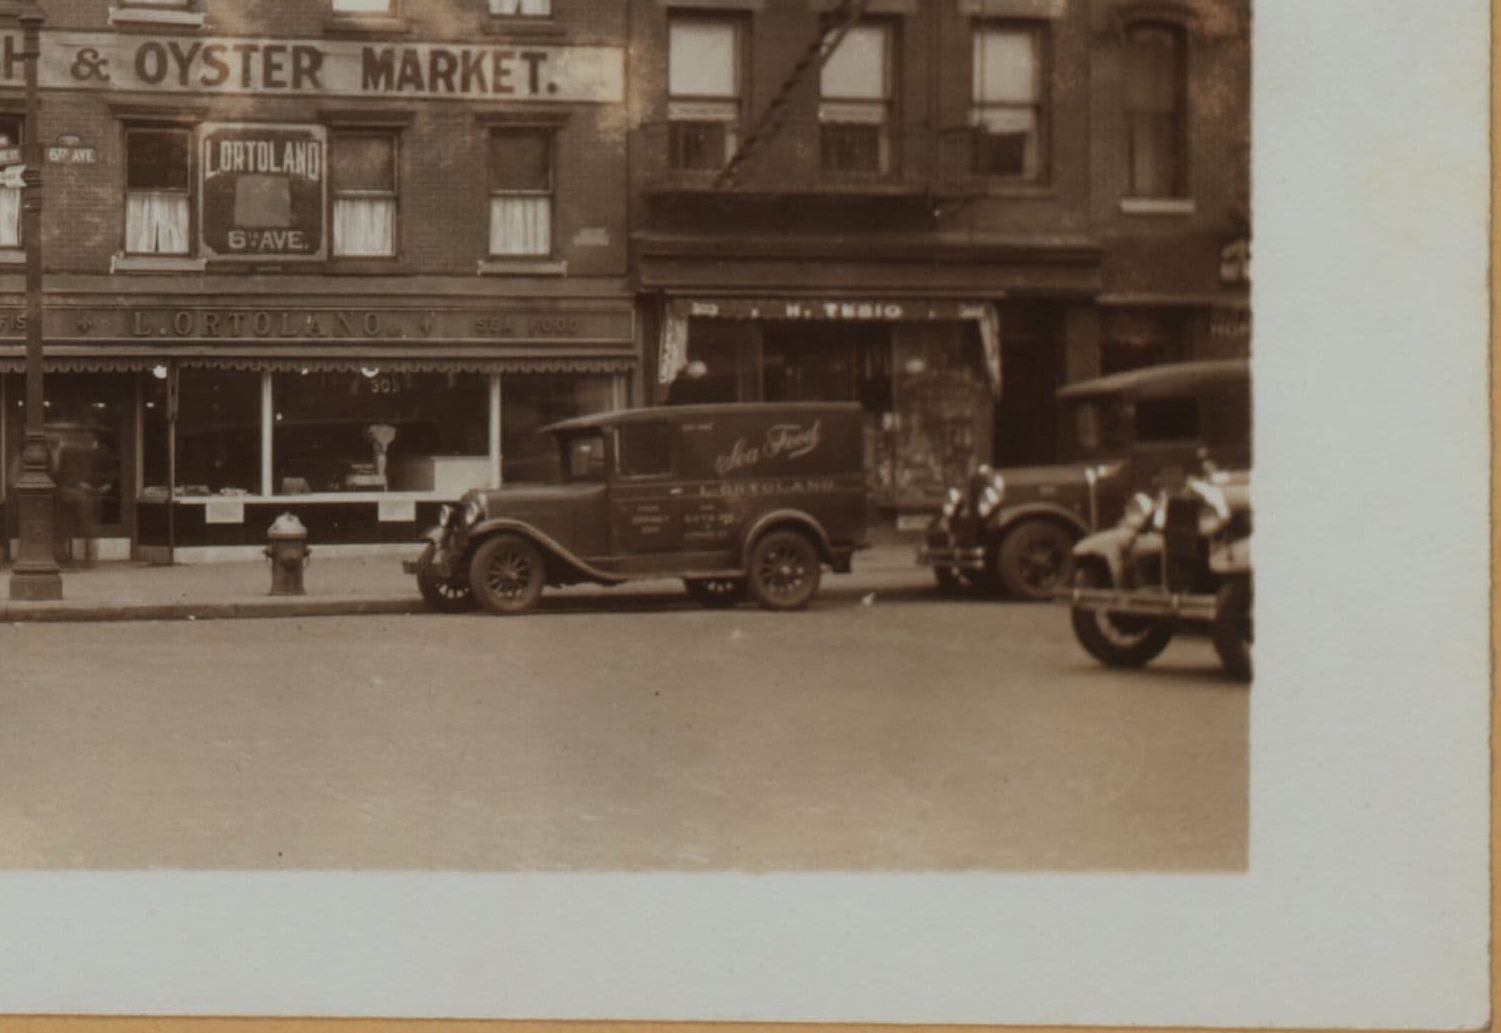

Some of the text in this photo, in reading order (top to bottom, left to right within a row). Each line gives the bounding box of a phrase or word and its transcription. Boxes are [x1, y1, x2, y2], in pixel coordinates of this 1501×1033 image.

[70, 47, 111, 82] &
[135, 41, 324, 89] OYSTER
[361, 45, 558, 95] MARKET.
[0, 313, 29, 334] FIS
